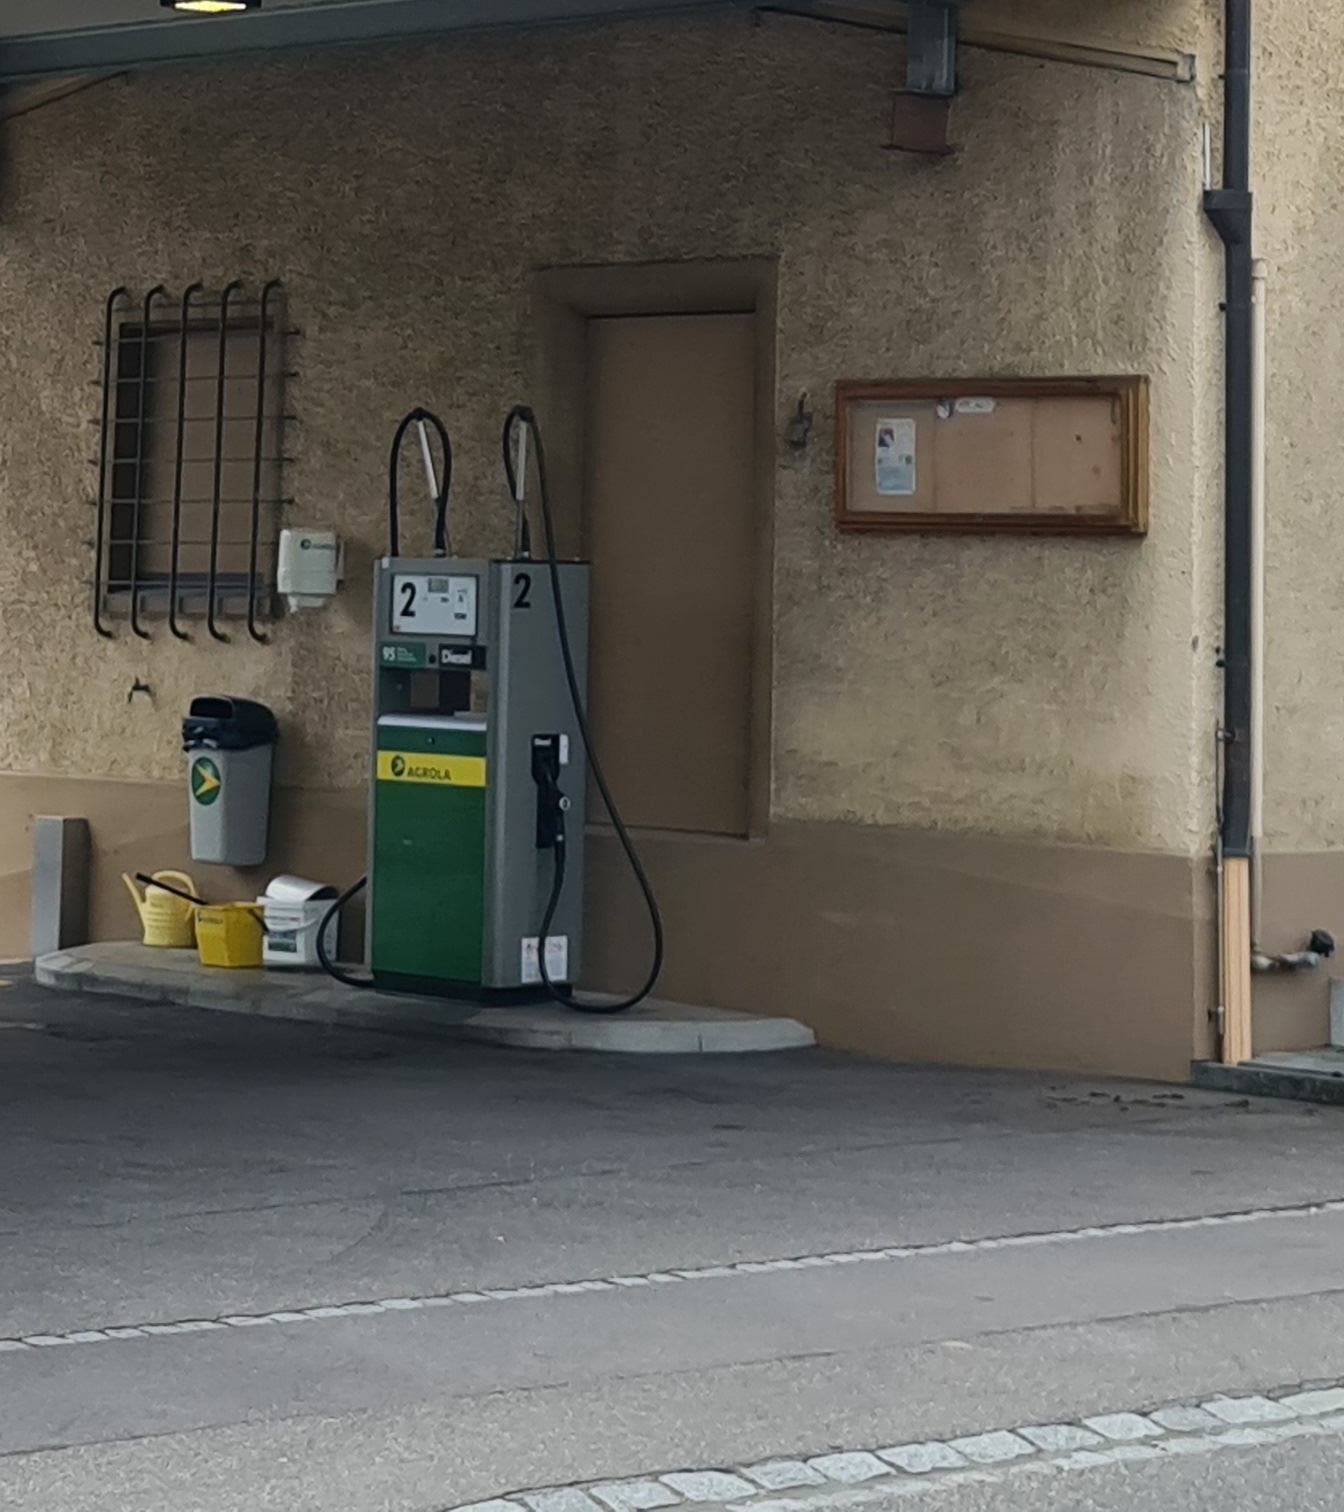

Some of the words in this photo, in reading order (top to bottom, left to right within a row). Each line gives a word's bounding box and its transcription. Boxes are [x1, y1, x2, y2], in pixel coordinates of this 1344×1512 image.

[400, 582, 417, 617] 2
[513, 572, 532, 609] 2
[407, 767, 452, 781] AGROLA
